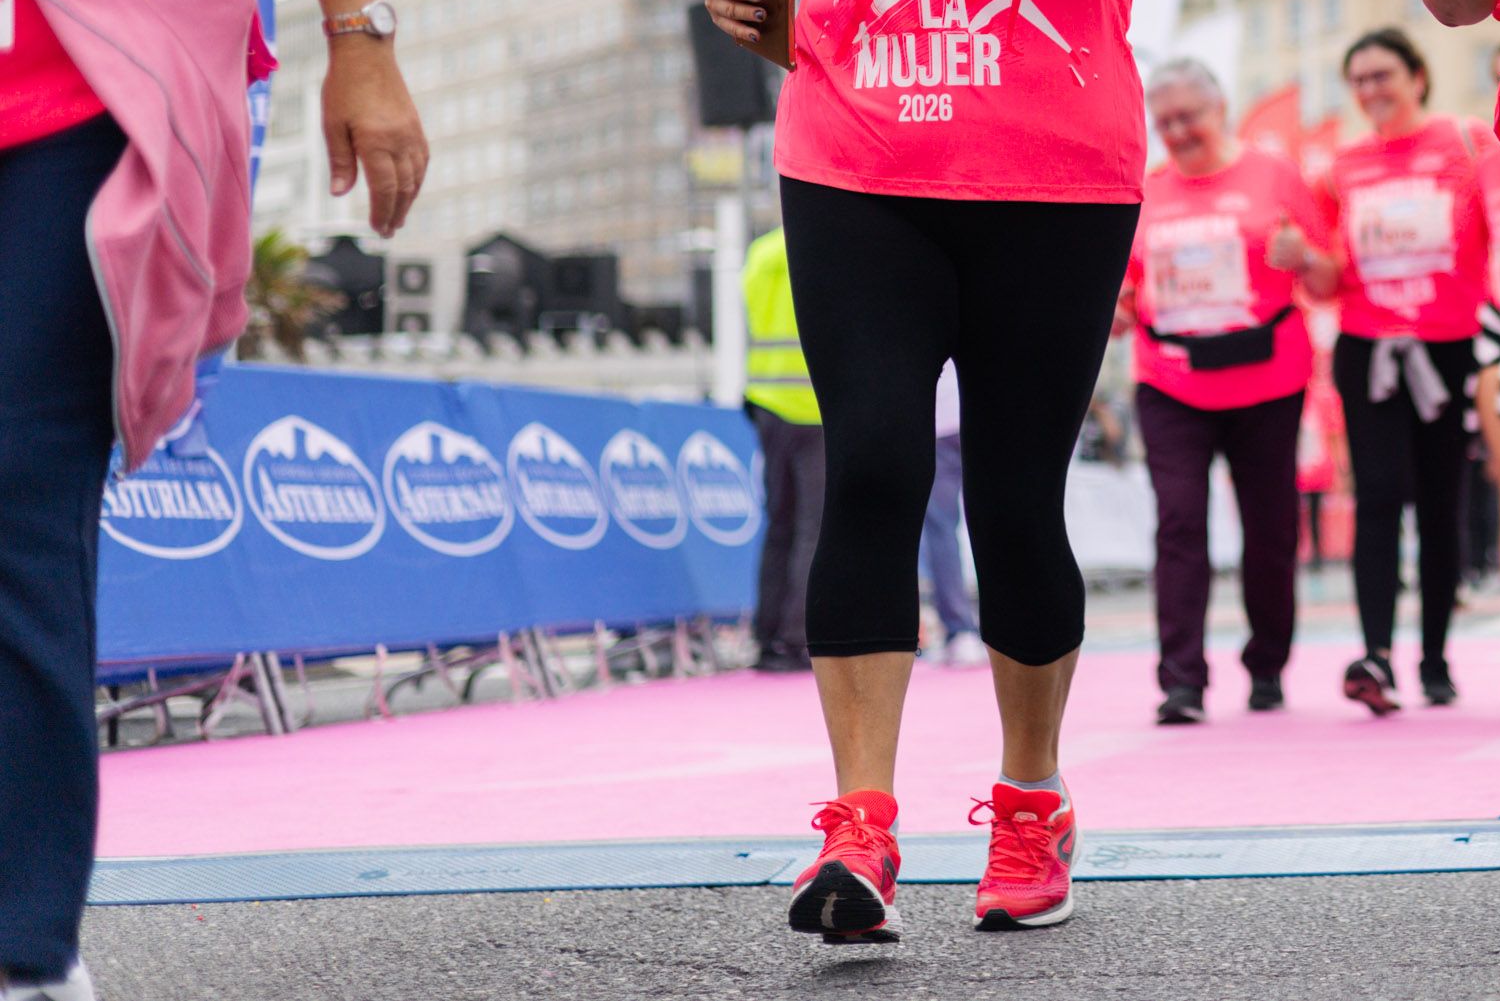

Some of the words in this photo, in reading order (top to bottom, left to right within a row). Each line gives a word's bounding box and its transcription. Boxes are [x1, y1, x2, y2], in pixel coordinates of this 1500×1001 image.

[853, 31, 1001, 90] MUJER
[898, 93, 953, 122] 2026
[257, 464, 377, 523] ASTURIANA
